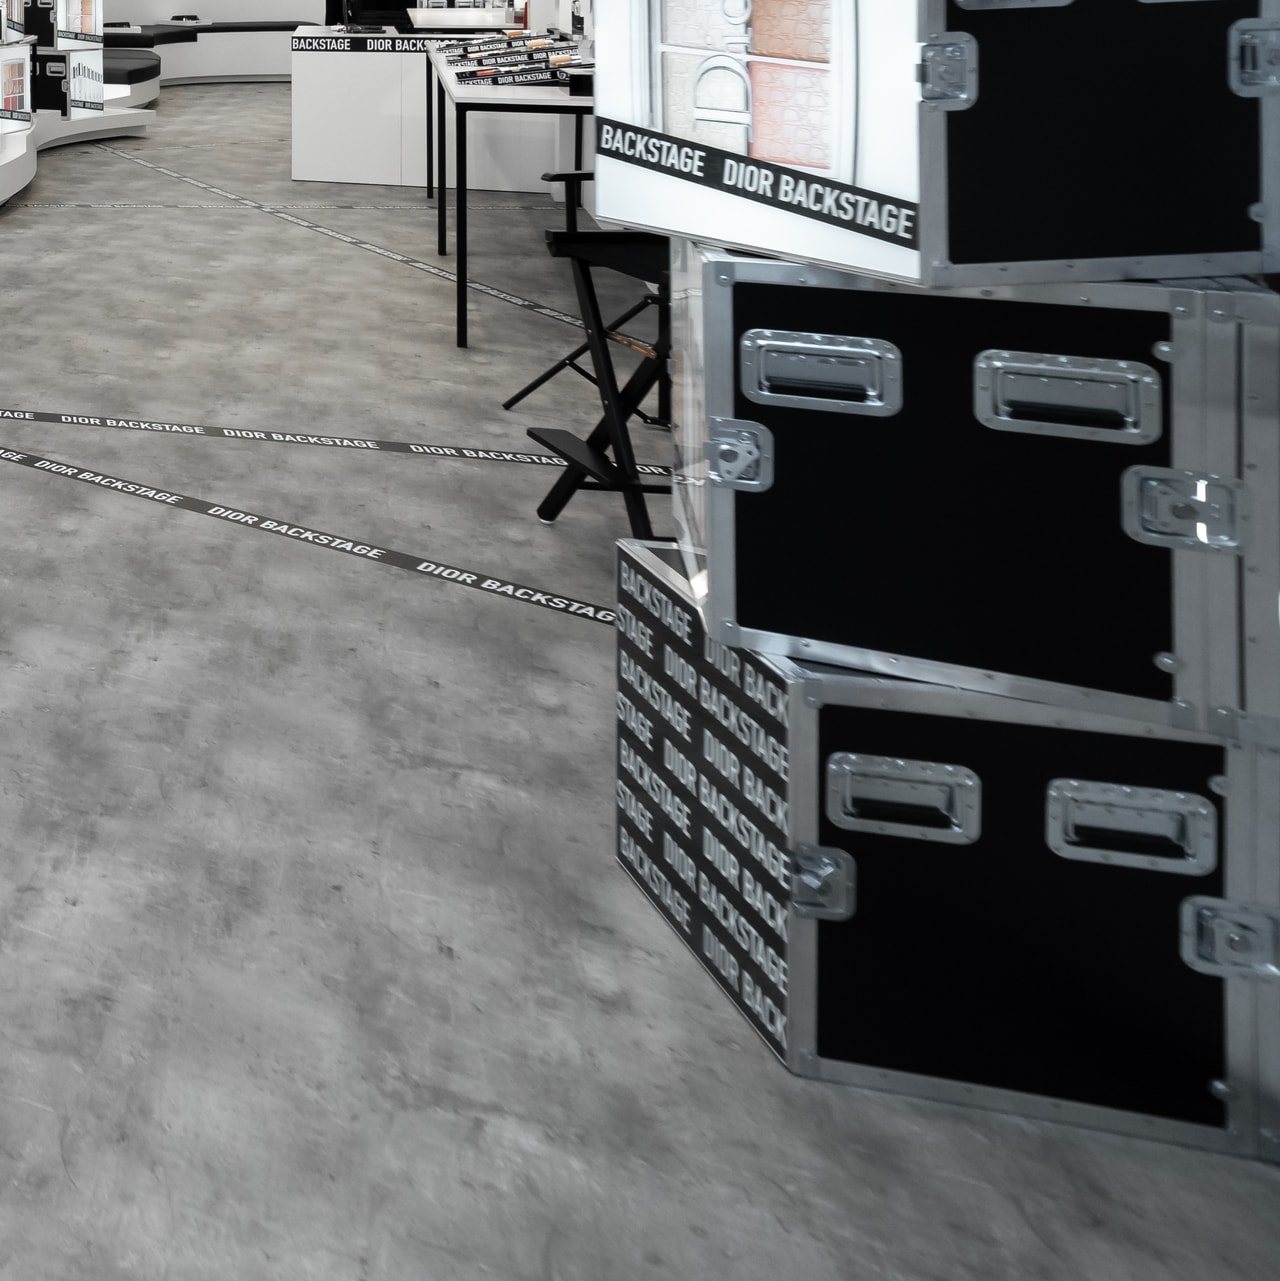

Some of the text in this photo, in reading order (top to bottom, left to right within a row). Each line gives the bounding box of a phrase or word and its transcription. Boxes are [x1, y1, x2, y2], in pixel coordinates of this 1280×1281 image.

[292, 38, 392, 51] BACKSTAGE DIOR
[480, 43, 507, 51] BACKSTAGE
[482, 57, 496, 65] DIOR
[497, 54, 528, 64] BACKSTAGE
[497, 76, 514, 84] DIOR
[514, 72, 552, 82] BACKSTAGE
[601, 125, 915, 240] BACKSTAGE DIOR BACKSTAGE
[61, 415, 101, 426] DIOR
[106, 419, 206, 435] BACKSTAGE
[223, 429, 569, 466] DIOR BACKSTAGE DIOR BACKSTAG
[33, 460, 78, 477] DIOR
[77, 472, 184, 505] BACKSTAGE
[207, 506, 259, 525] DIOR
[259, 520, 387, 559] BACKSTAGE
[415, 561, 476, 585] DIOR
[479, 578, 617, 622] BACKSTAG
[621, 560, 692, 647] BACKSTAGE
[743, 661, 789, 728] BACK
[618, 602, 789, 783] STAGE DIOR BACKSTAGE
[617, 778, 788, 997] STAGE DIOR BACKSTAGE
[620, 825, 787, 1050] BACKSTAGE DIOR BACK
